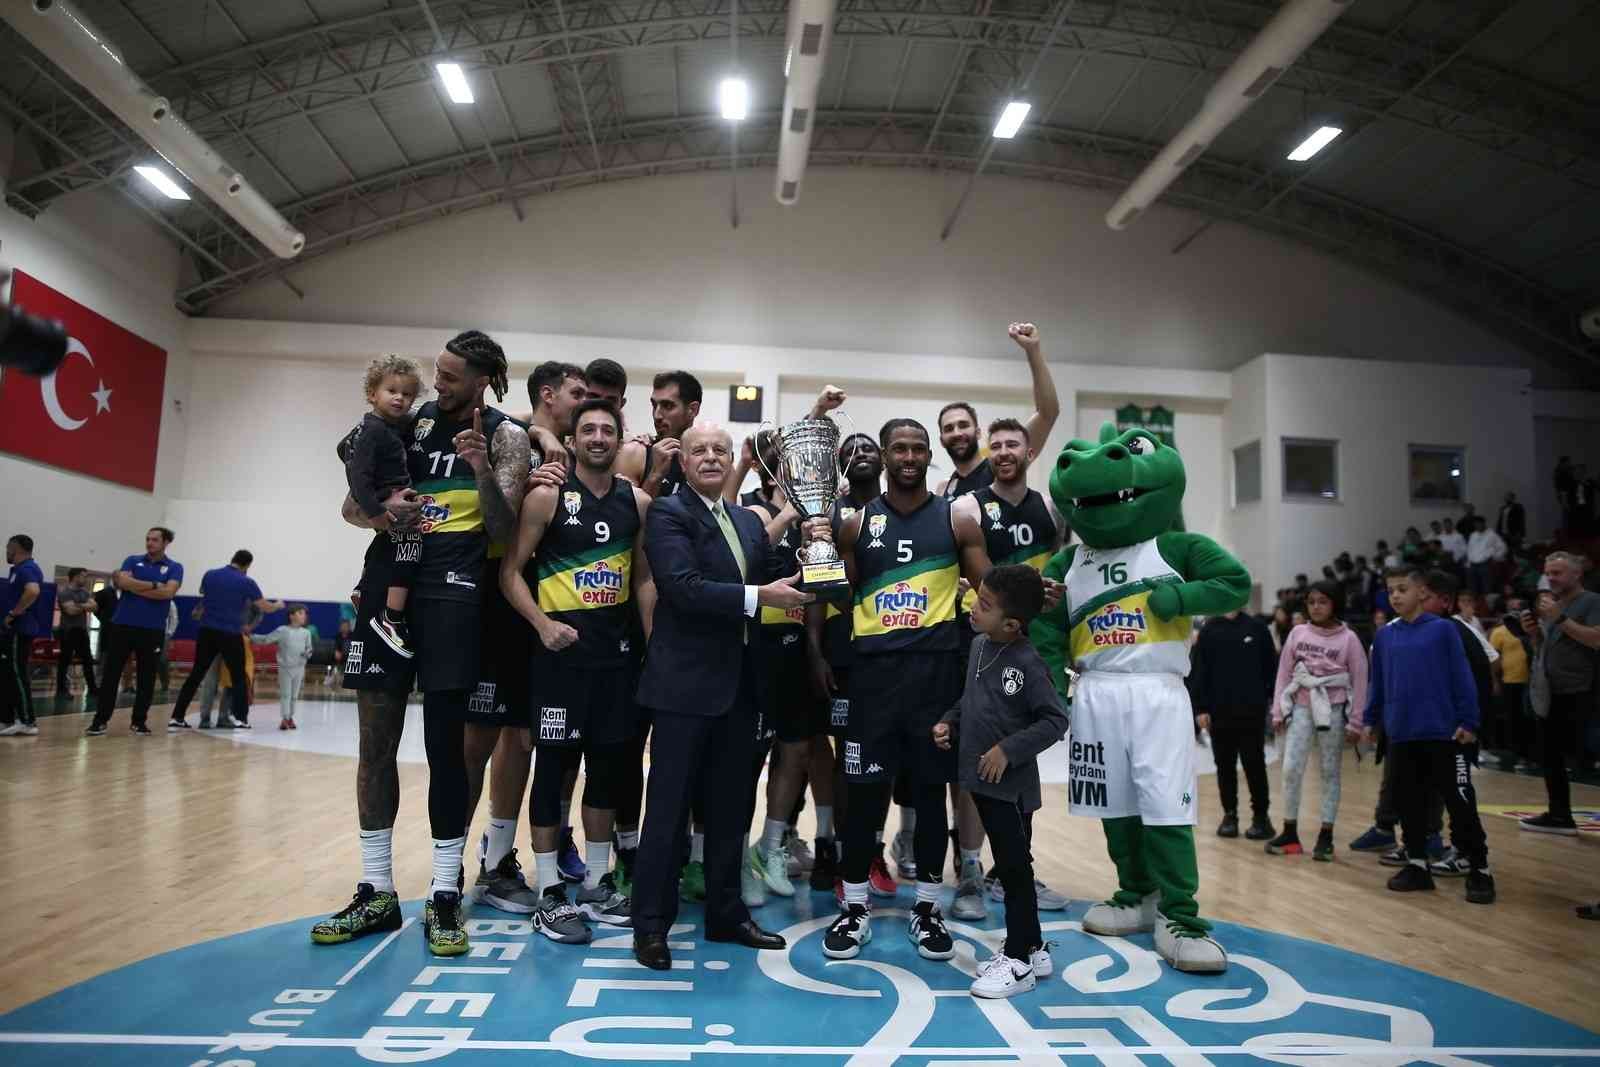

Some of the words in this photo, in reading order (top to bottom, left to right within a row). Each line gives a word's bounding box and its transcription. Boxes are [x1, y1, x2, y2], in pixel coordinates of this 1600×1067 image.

[428, 451, 456, 478] 11
[594, 521, 610, 543] 9
[1009, 523, 1033, 546] 10
[897, 540, 913, 563] 5
[1098, 562, 1128, 585] 16
[582, 590, 617, 604] extra
[881, 612, 919, 628] extra
[1093, 630, 1136, 645] extra
[1002, 667, 1024, 685] NETS
[477, 684, 496, 696] ent
[542, 708, 566, 720] Kent
[541, 727, 564, 738] AVM
[846, 744, 860, 755] ent
[1069, 734, 1105, 765] ent
[846, 761, 861, 774] VM
[1069, 763, 1106, 779] eydanı
[1455, 754, 1468, 784] NIKE
[1068, 779, 1108, 807] VM
